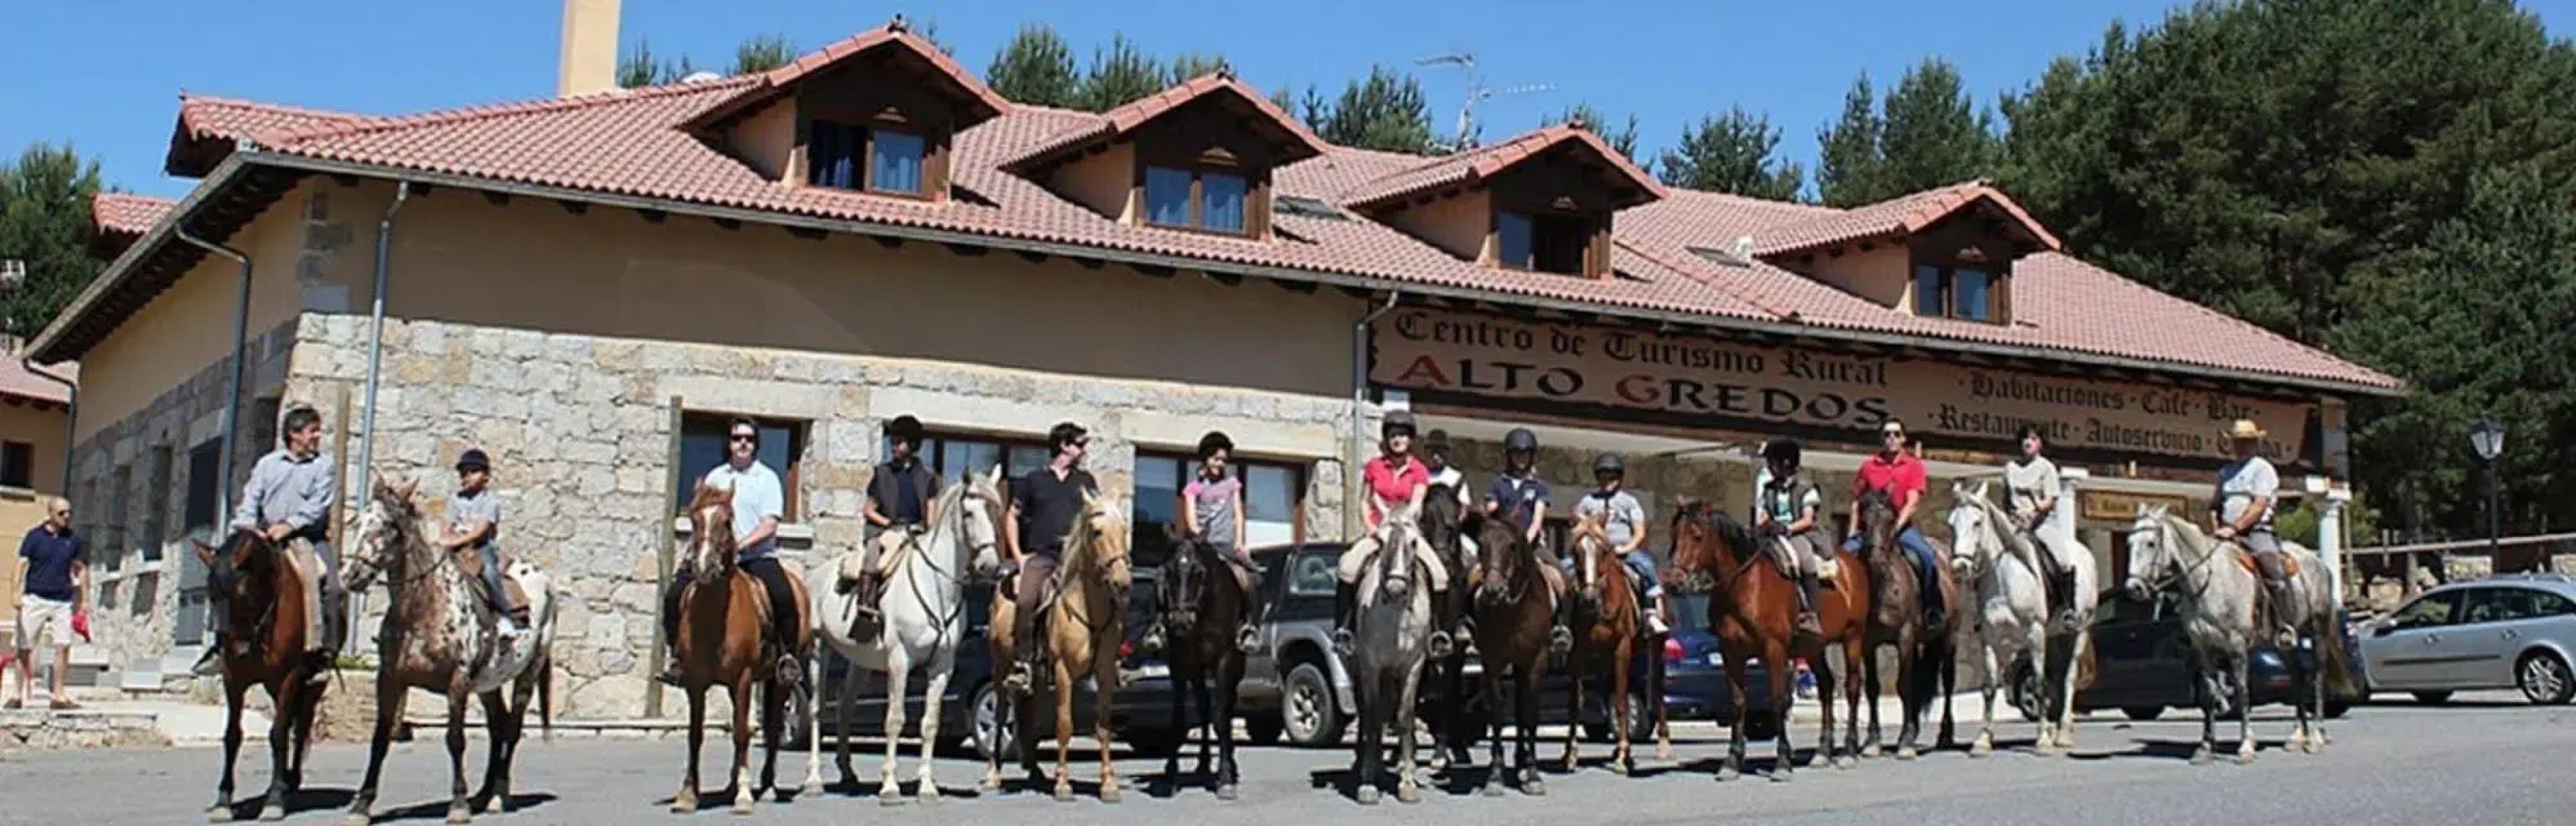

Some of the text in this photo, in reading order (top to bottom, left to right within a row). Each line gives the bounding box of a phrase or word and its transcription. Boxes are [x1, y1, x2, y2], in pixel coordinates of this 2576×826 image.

[1395, 311, 1887, 387] Centro de Turismo Rural
[1397, 355, 1891, 426] ALTO GREDOS
[1969, 370, 2123, 408] Habitaciones
[2208, 393, 2253, 421] Bar
